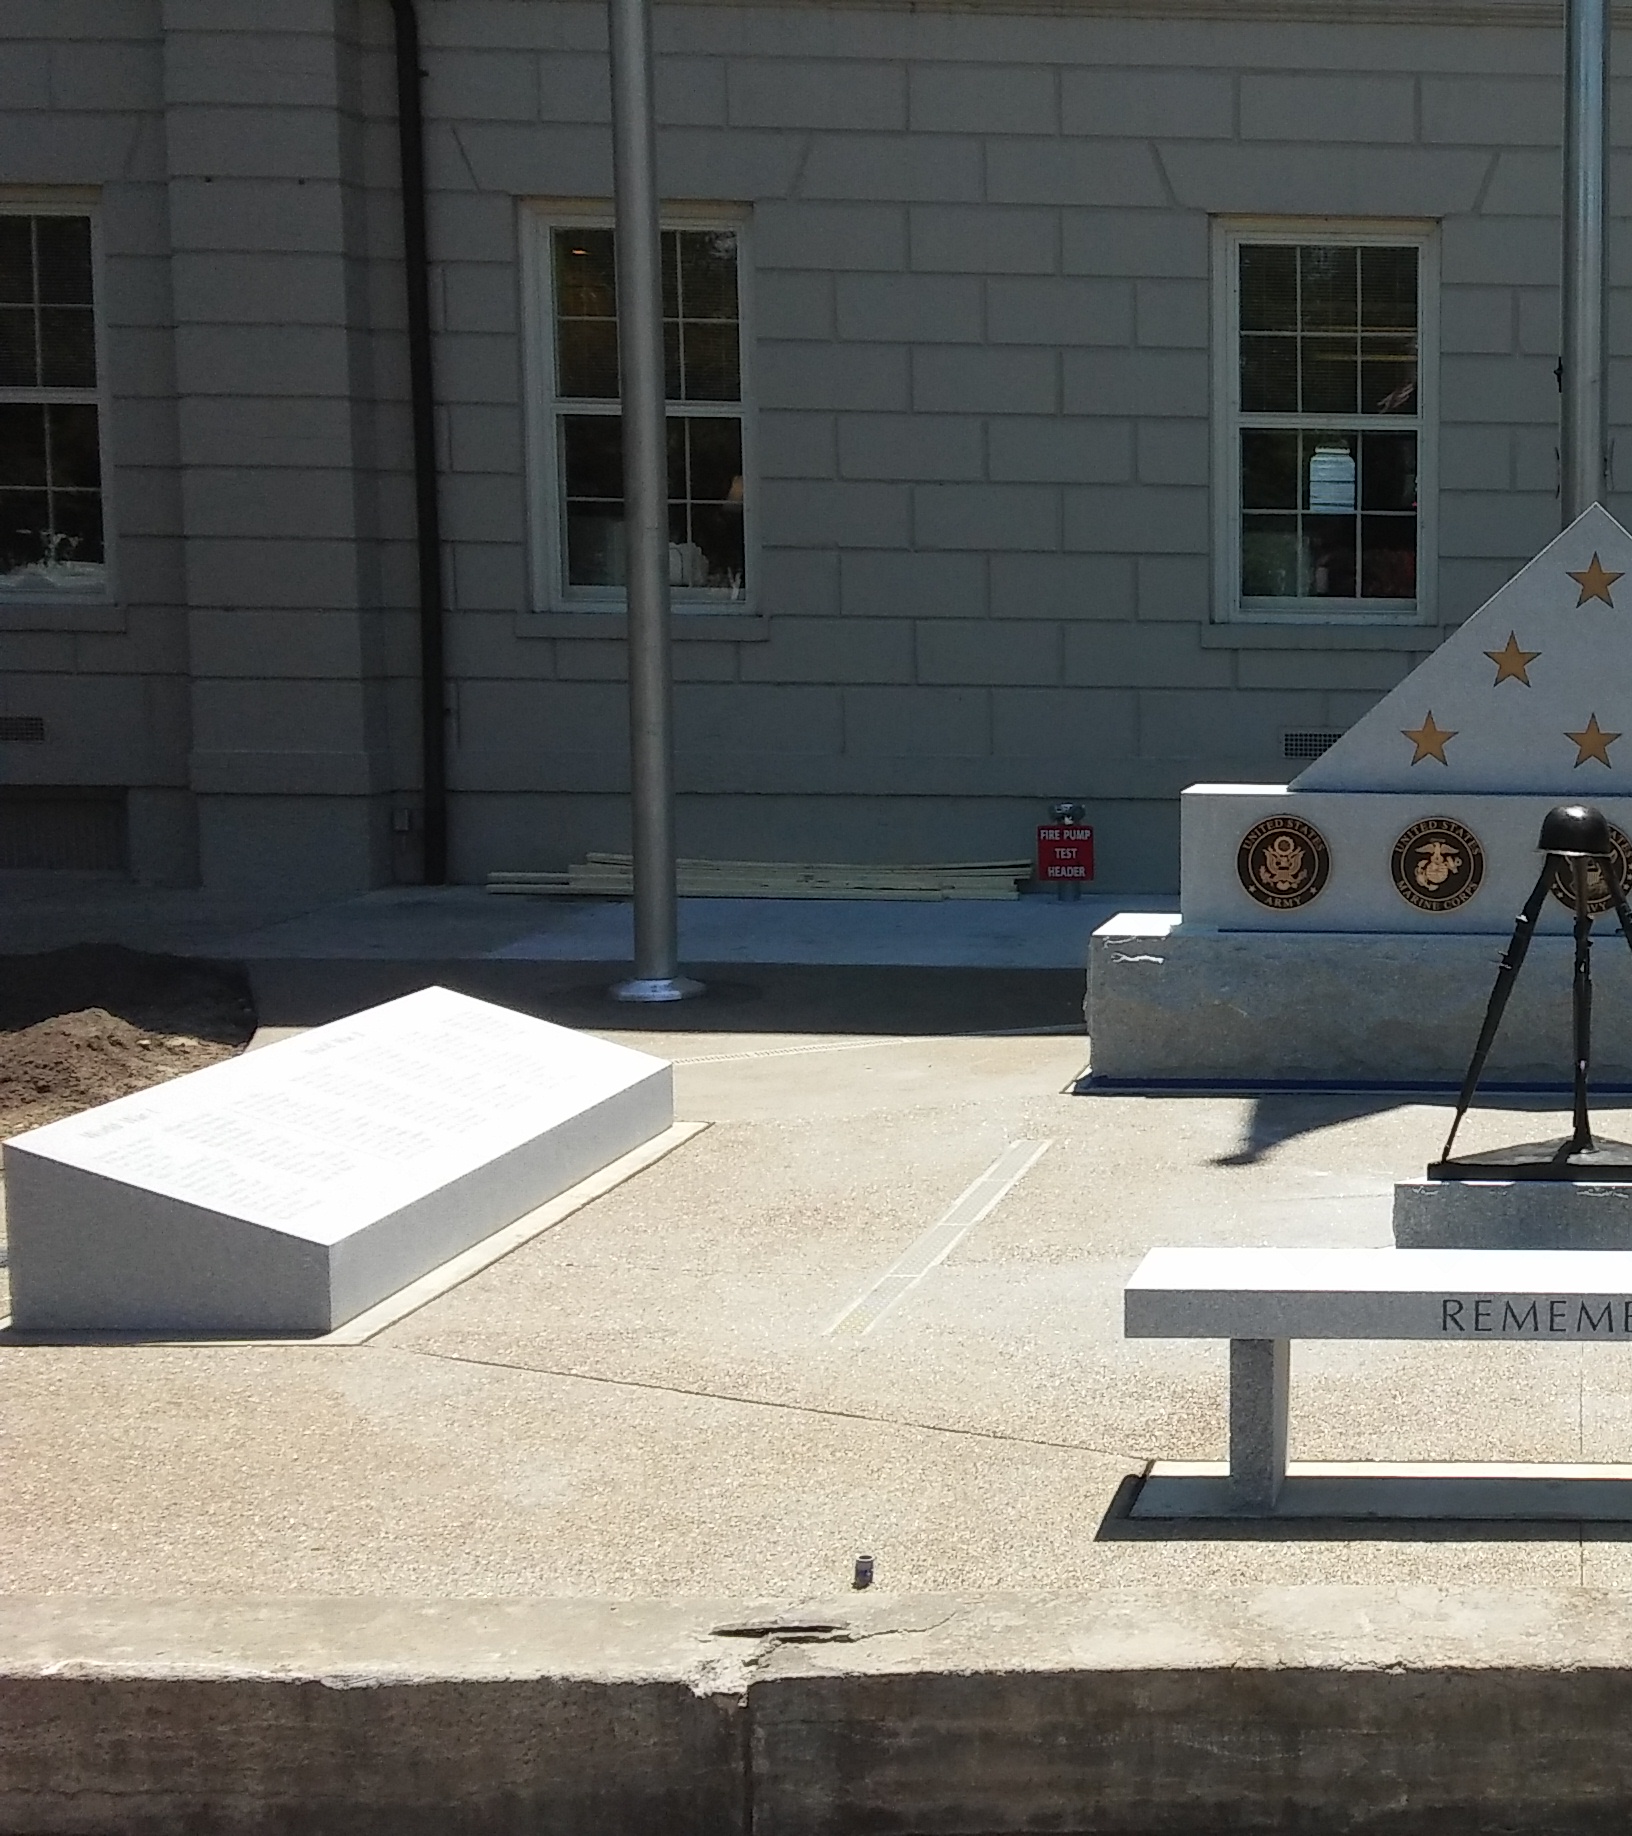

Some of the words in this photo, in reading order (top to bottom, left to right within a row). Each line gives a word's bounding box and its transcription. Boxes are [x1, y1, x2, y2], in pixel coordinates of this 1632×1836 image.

[1040, 829, 1060, 840] FIRE
[1063, 829, 1091, 840] PUMP
[1242, 819, 1284, 849] UNITED
[1287, 820, 1325, 851] STATES
[1395, 821, 1438, 853] UNITED
[1442, 821, 1480, 855] STATES
[1054, 847, 1078, 859] TEST
[1047, 866, 1086, 877] HEADER
[1397, 880, 1440, 910] MARINE
[1443, 882, 1479, 909] CORPS
[1265, 896, 1302, 907] ARMY
